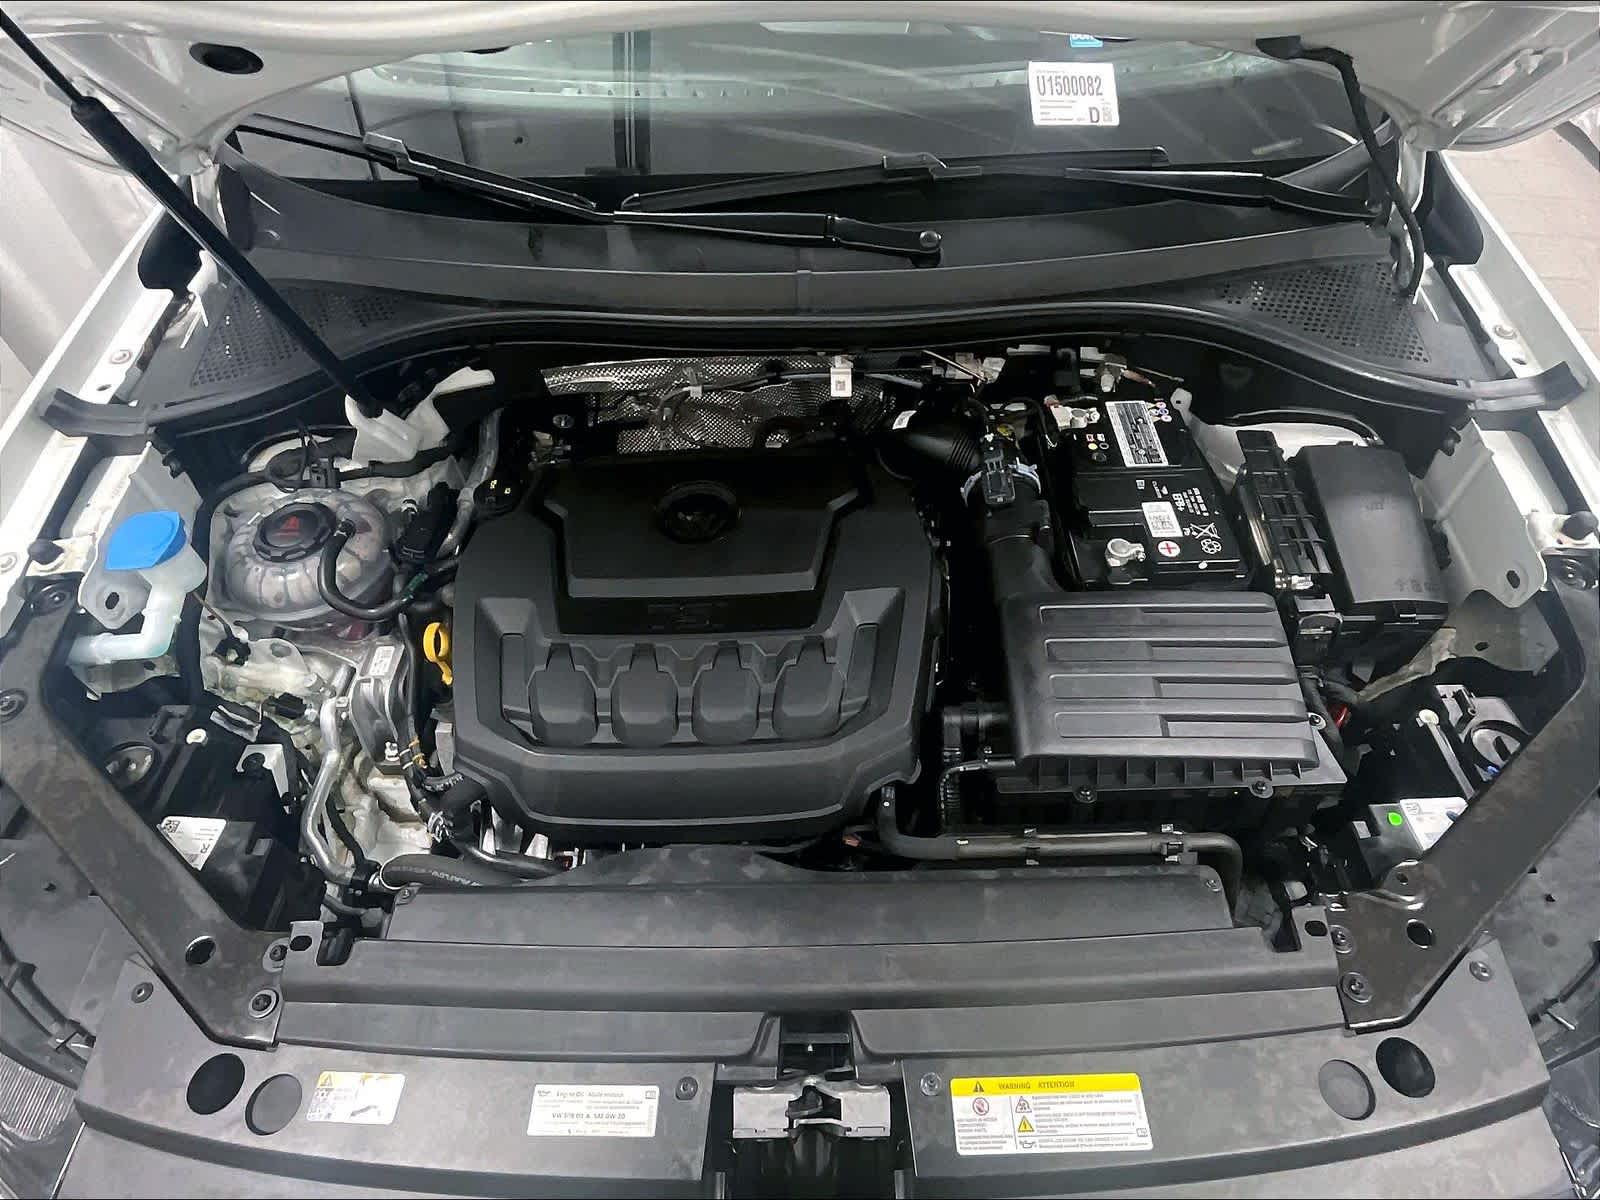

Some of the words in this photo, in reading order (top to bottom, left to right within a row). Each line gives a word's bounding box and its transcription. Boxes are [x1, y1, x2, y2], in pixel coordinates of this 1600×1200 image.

[1036, 76, 1103, 96] U1500082
[1088, 107, 1100, 124] D
[998, 1081, 1031, 1090] WARNING
